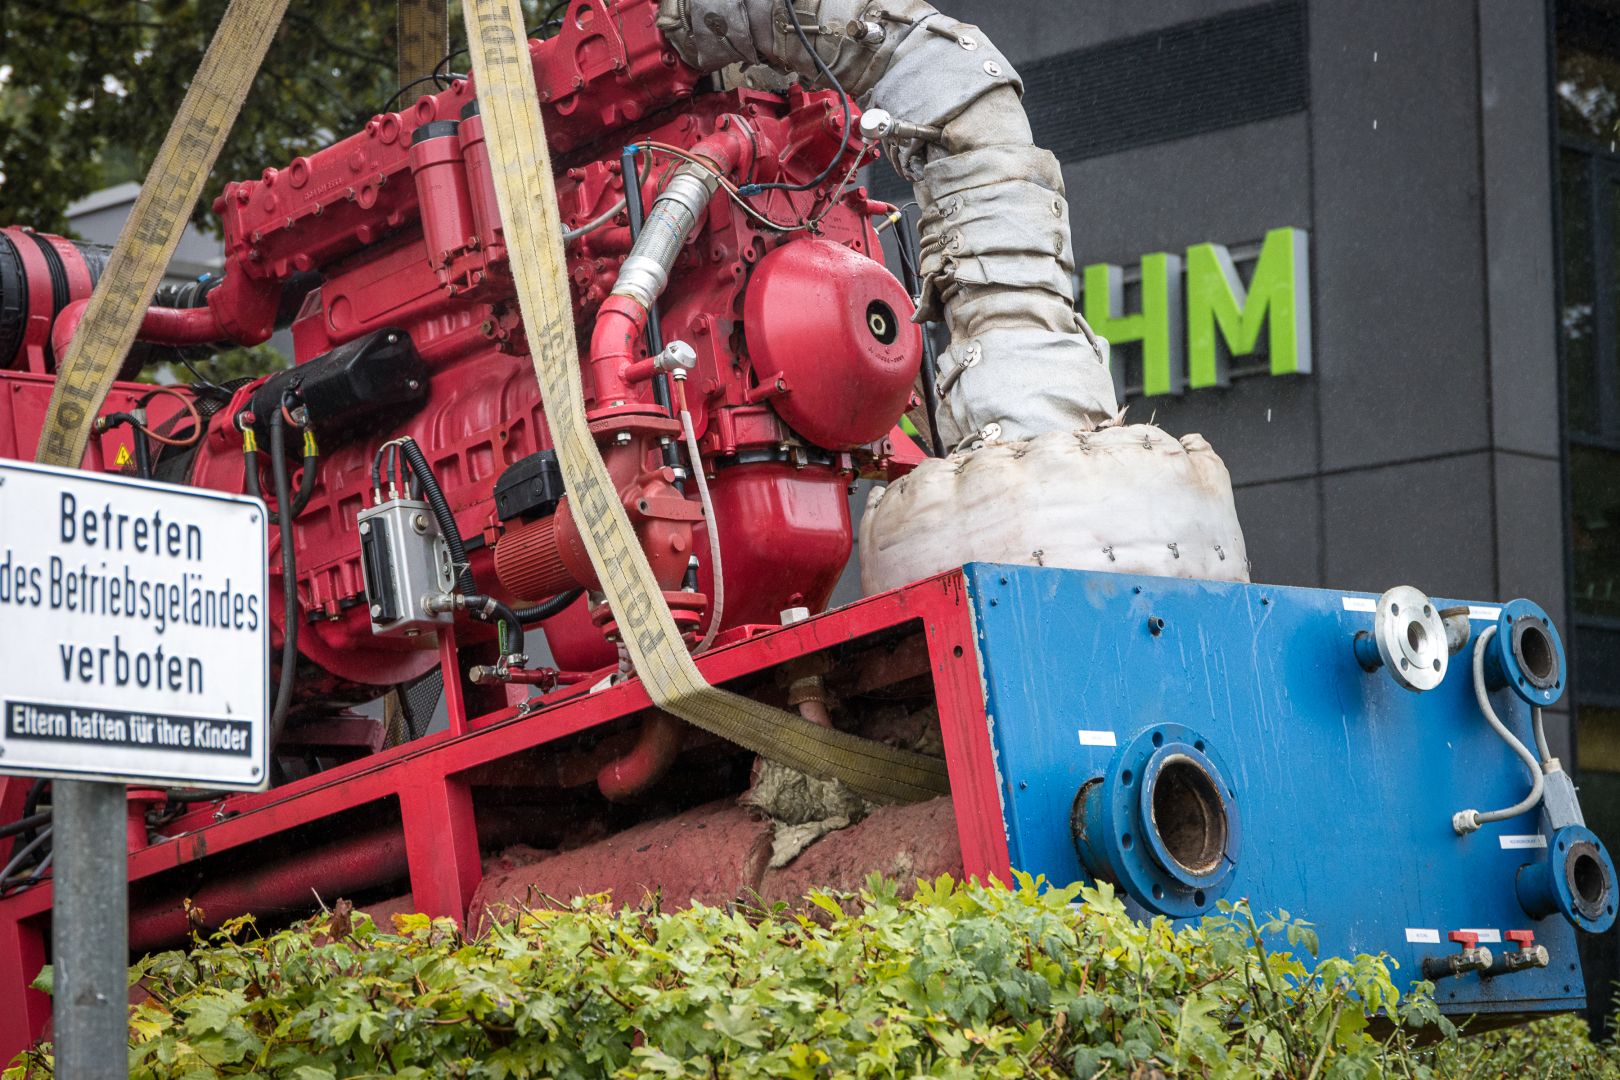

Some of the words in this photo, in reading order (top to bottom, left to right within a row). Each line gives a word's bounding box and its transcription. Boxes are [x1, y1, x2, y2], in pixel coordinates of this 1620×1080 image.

[61, 492, 203, 561] Betreten
[0, 549, 41, 607] des
[50, 556, 258, 635] Betriebsgeländes
[60, 635, 203, 695] verboten
[12, 704, 67, 736] Eltern
[71, 710, 126, 742] haften
[129, 713, 154, 744] für
[157, 716, 191, 747] ihre
[193, 720, 248, 751] Kinder
